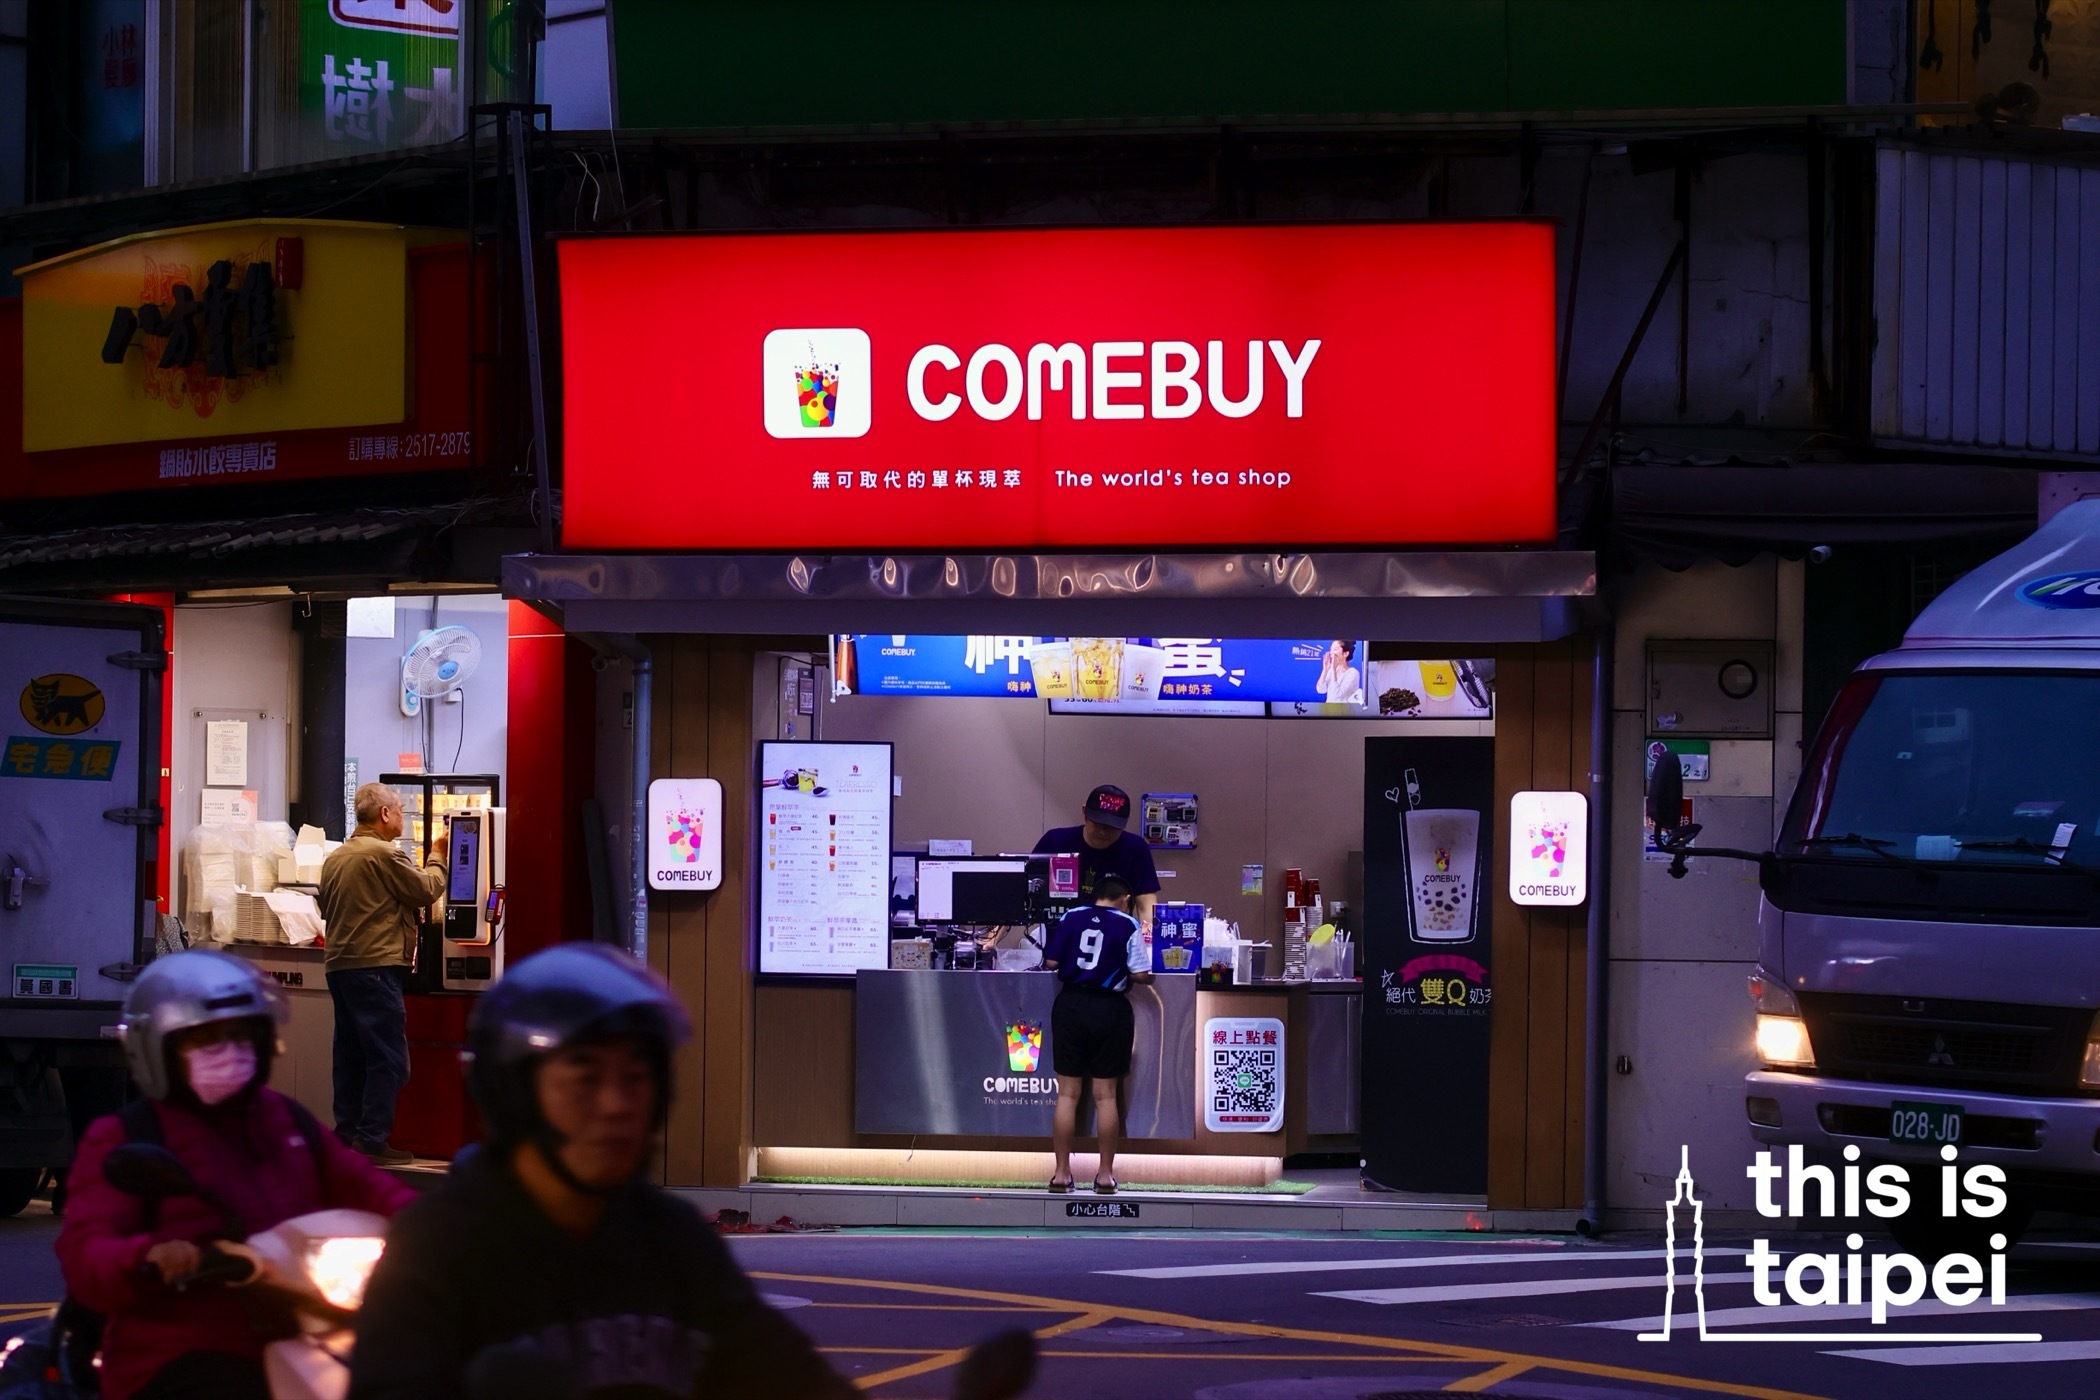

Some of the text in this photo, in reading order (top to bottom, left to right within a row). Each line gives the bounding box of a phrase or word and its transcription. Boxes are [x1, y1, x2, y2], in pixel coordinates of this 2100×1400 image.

[907, 340, 1322, 421] COMEBUY
[158, 441, 277, 479] 鍋貼水餃專賣店
[812, 469, 1022, 490] 無可取代的單杯現萃
[1055, 468, 1292, 489] The world's tea shop
[881, 648, 916, 656] COMEBUY
[1162, 683, 1213, 696] 嗨神奶茶
[8, 741, 114, 776] 宅急便
[657, 870, 713, 881] COMEBUY
[1425, 874, 1461, 883] COMEBUY
[1519, 885, 1576, 897] COMEBUY
[1076, 928, 1104, 971] 9
[1213, 1030, 1277, 1045] 線上點餐
[983, 1076, 1059, 1094] COMEBUY
[1045, 1097, 1058, 1106] sho
[1071, 1203, 1121, 1217] 小心台階
